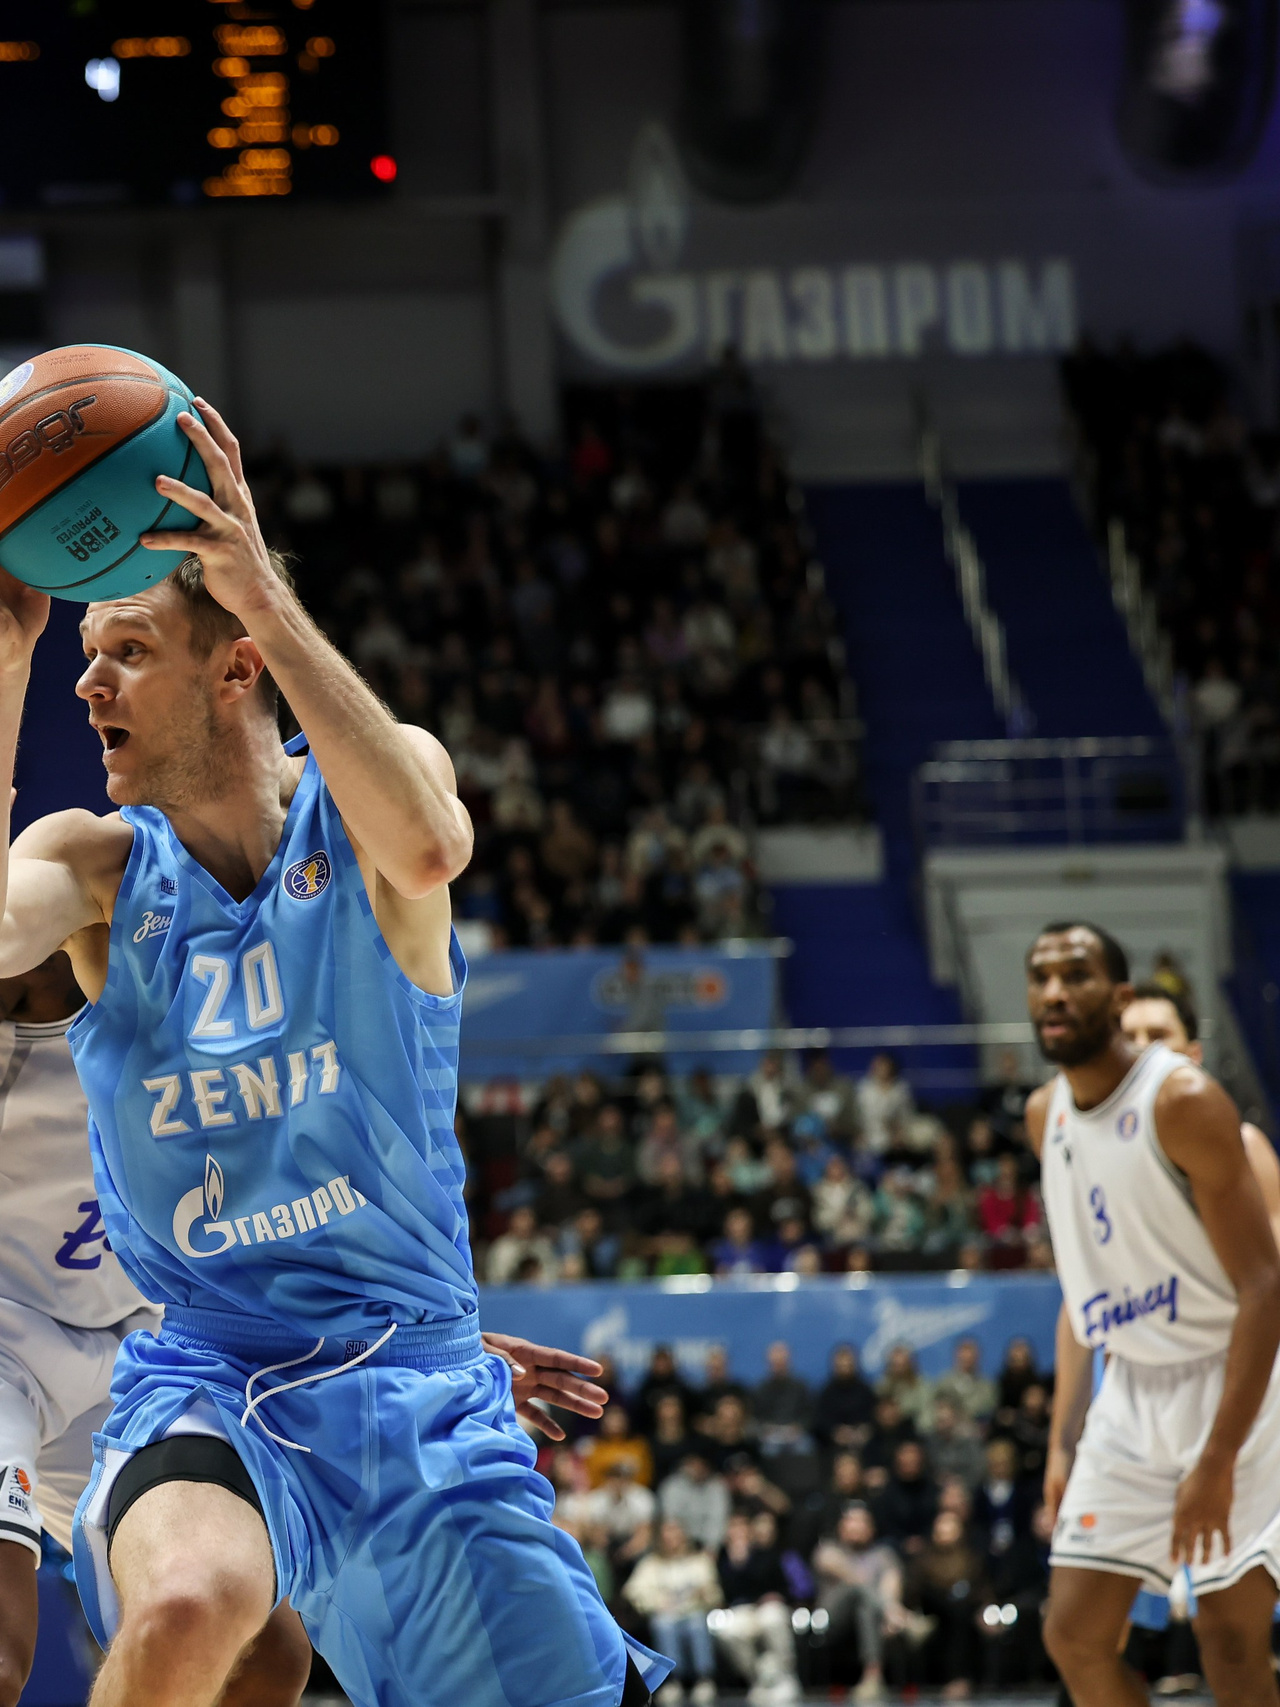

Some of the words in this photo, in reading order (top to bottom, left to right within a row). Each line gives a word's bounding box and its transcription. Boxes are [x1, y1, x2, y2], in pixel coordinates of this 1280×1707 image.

[706, 260, 1074, 360] ГАЗПРОМ
[56, 506, 102, 544] APPROVED
[65, 516, 121, 562] FIBA
[133, 911, 171, 943] Зен
[191, 940, 283, 1038] 20
[142, 1040, 342, 1138] ZENIT
